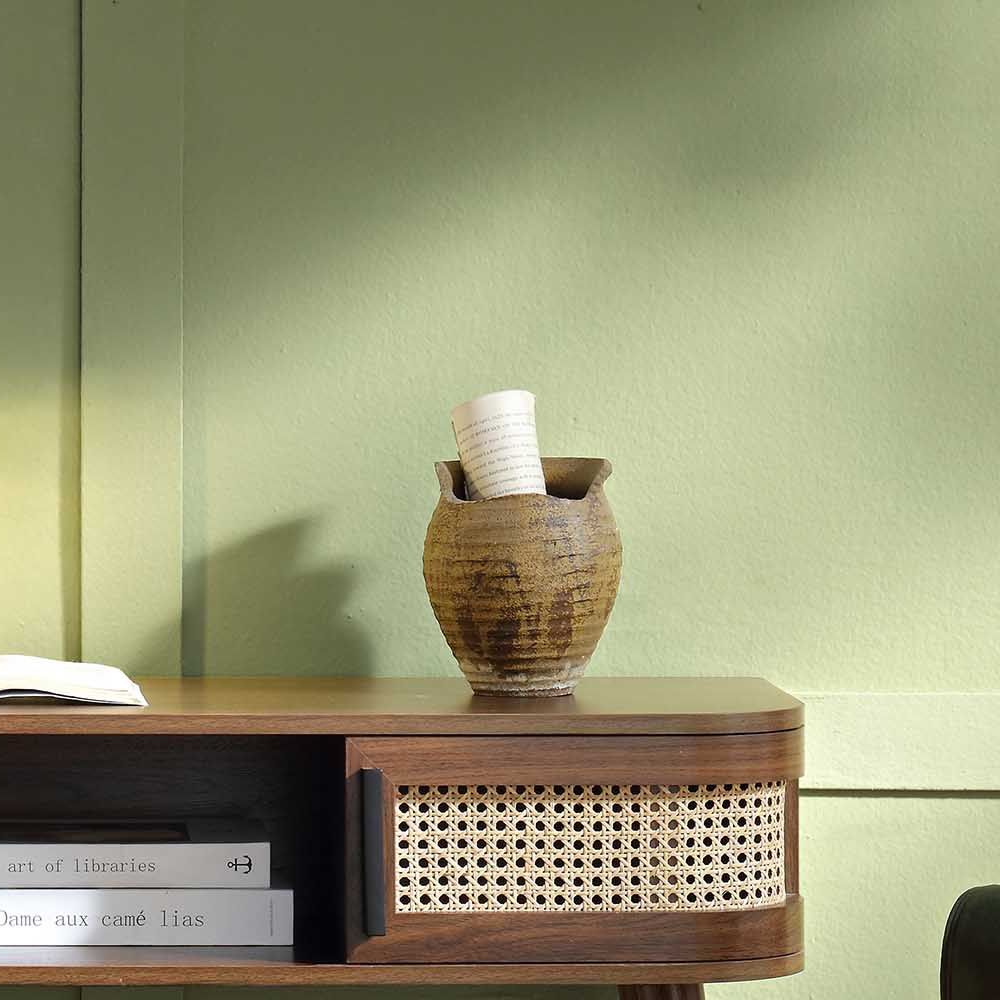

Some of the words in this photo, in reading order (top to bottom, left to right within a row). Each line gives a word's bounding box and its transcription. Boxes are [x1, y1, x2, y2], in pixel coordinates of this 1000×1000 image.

[7, 861, 35, 874] art
[44, 859, 65, 874] of
[74, 859, 156, 874] libraries
[55, 914, 89, 927] aux
[101, 911, 146, 928] camé
[160, 909, 206, 928] lias
